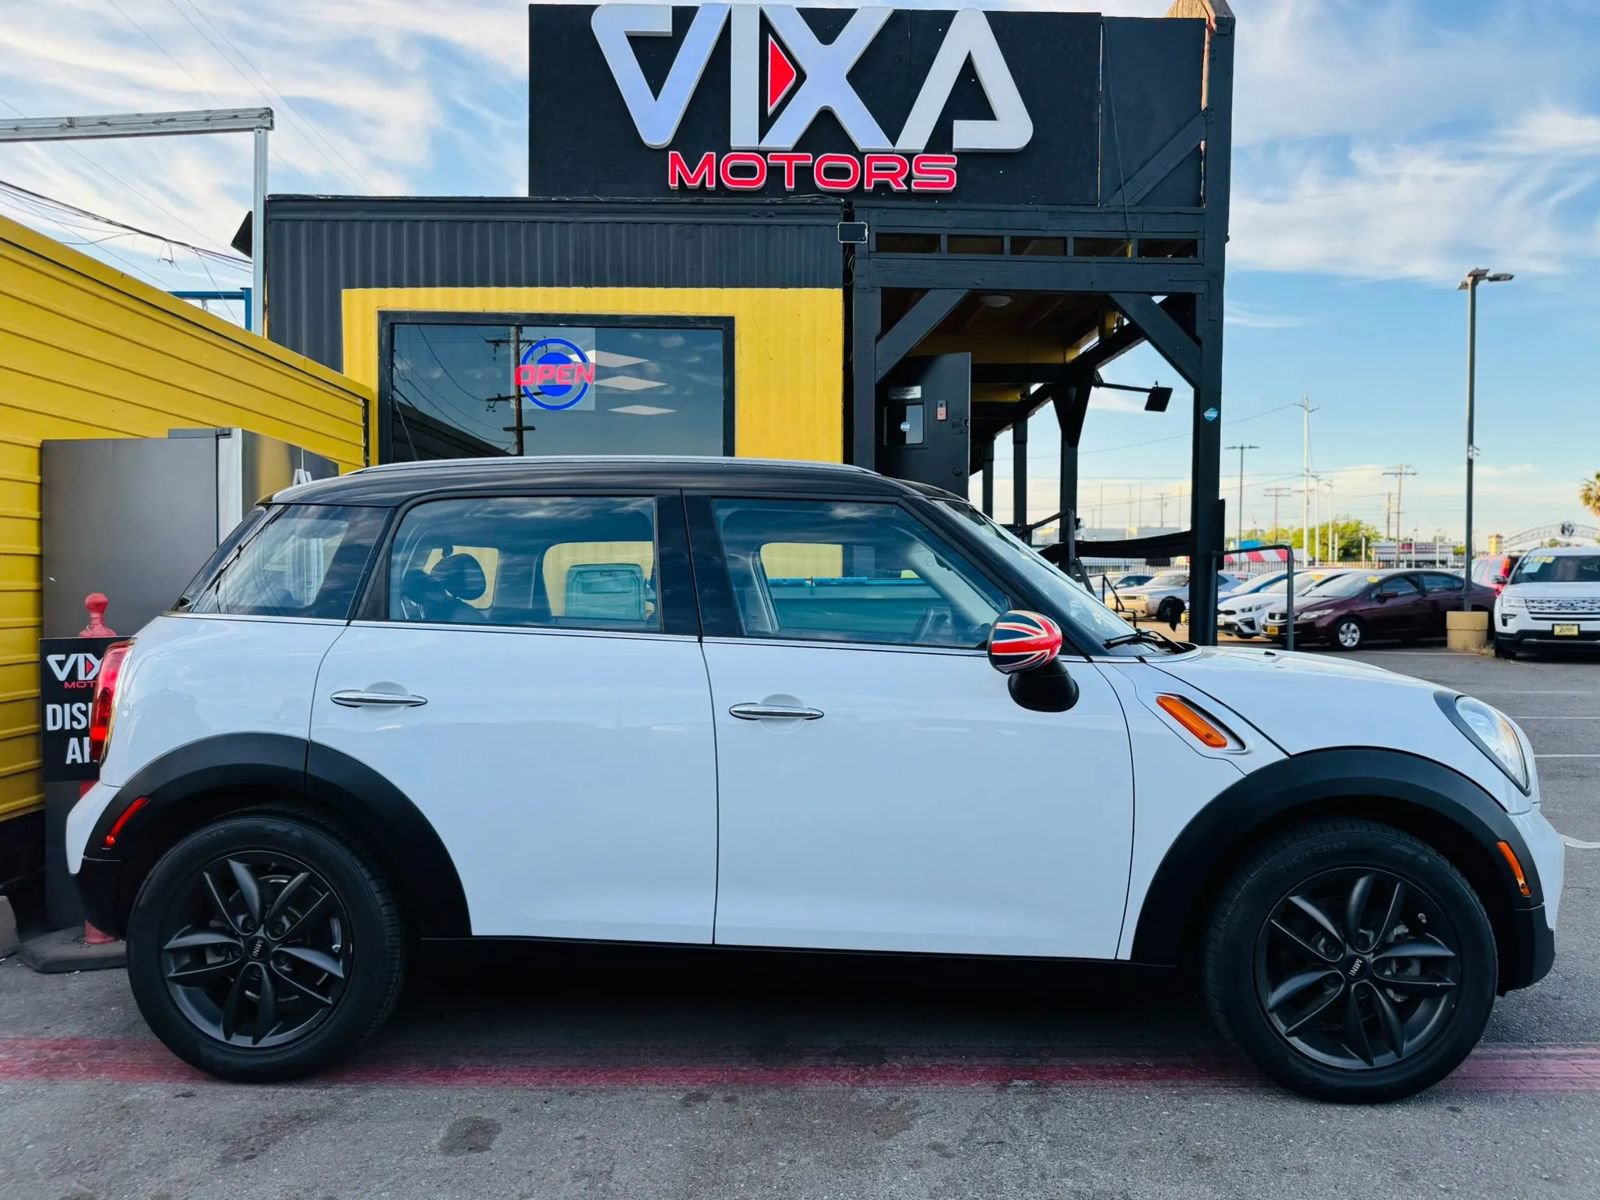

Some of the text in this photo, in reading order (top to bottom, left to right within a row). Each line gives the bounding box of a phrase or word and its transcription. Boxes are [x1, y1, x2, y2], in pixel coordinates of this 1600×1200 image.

[590, 2, 1034, 152] VIXA
[668, 151, 958, 191] MOTORS
[515, 364, 595, 386] OPEN
[46, 653, 103, 681] VIX
[1348, 958, 1363, 977] MINI
